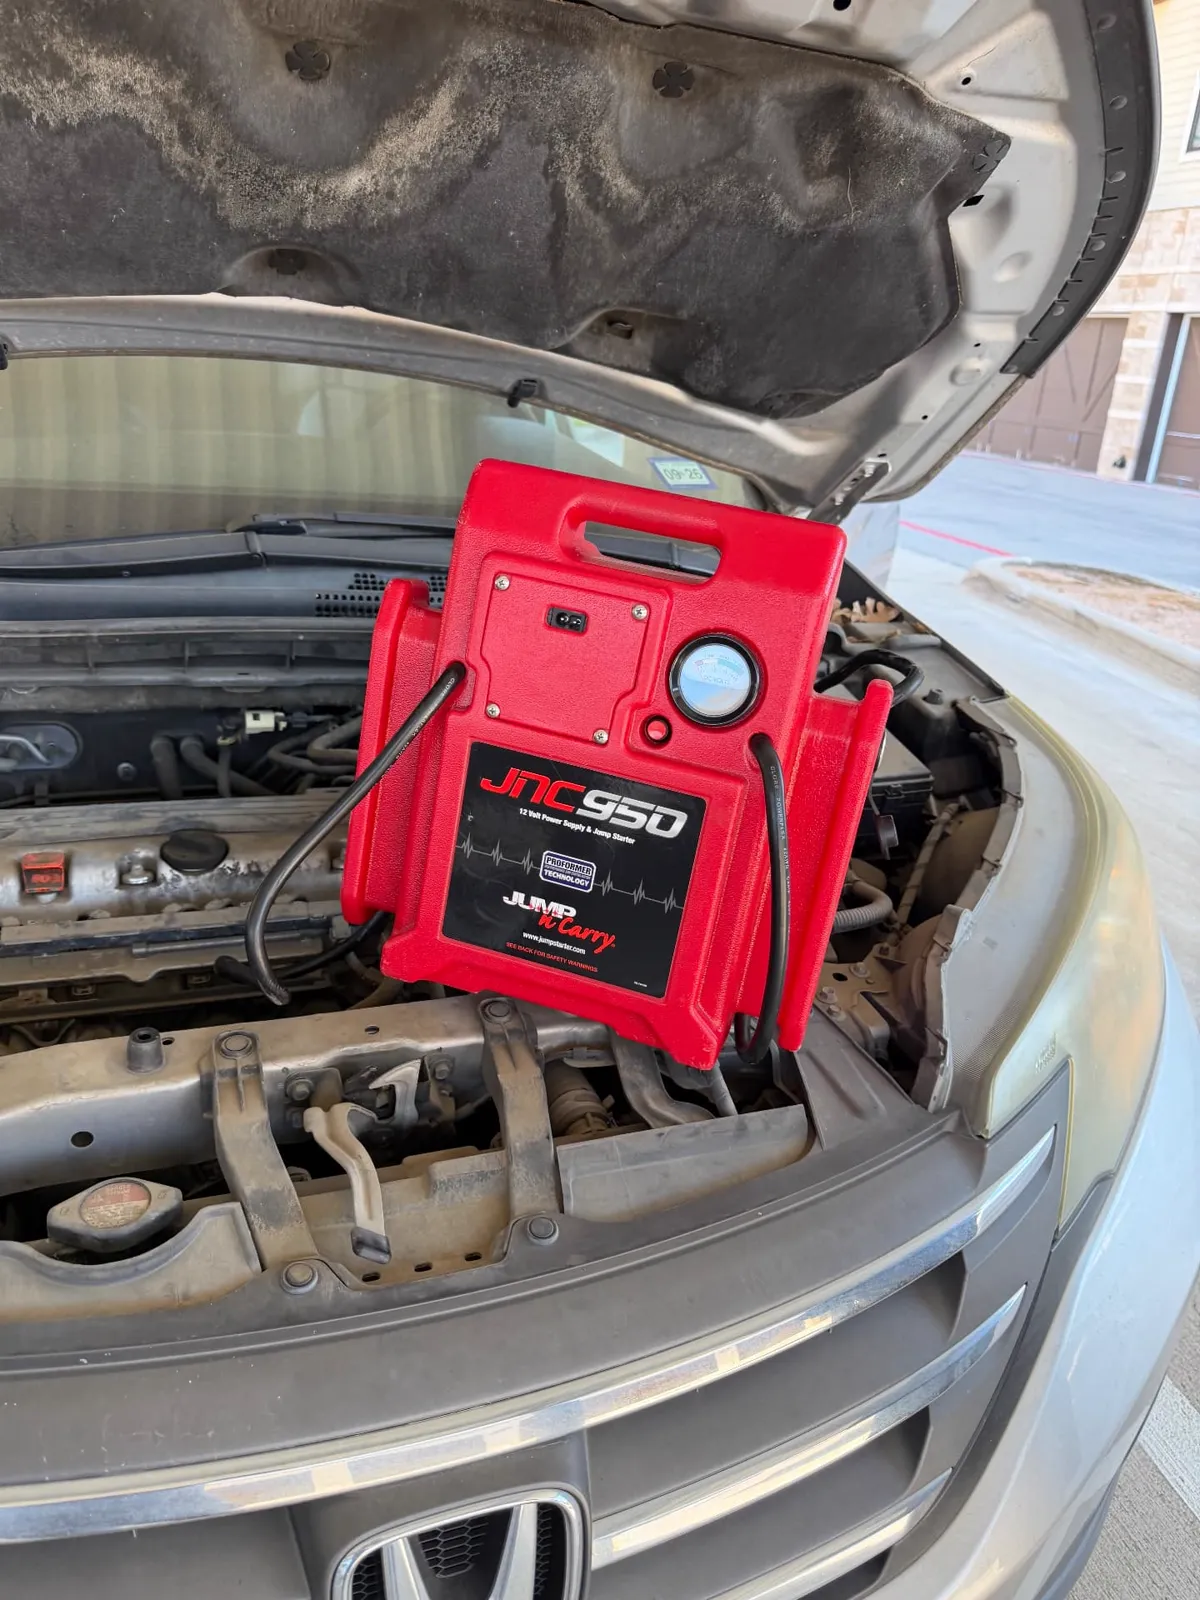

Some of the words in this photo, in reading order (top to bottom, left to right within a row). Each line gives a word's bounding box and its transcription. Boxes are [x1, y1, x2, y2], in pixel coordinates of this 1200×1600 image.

[519, 807, 528, 816] 12
[528, 810, 541, 819] Volt
[541, 812, 563, 826] Power
[563, 818, 586, 833] Supply
[586, 825, 592, 833] &
[592, 827, 612, 840] Jump
[612, 832, 636, 845] Starter
[544, 868, 590, 887] TECHNOLOGY
[546, 856, 593, 876] PROFORMER
[502, 890, 577, 919] JUMP
[522, 931, 586, 955] www.jumpstarter.com
[557, 917, 616, 955] Carry
[506, 941, 517, 950] SEE
[517, 944, 534, 955] BACK
[533, 948, 546, 958] FOR
[546, 952, 567, 964] SAFETY
[567, 959, 598, 973] WARNINGS
